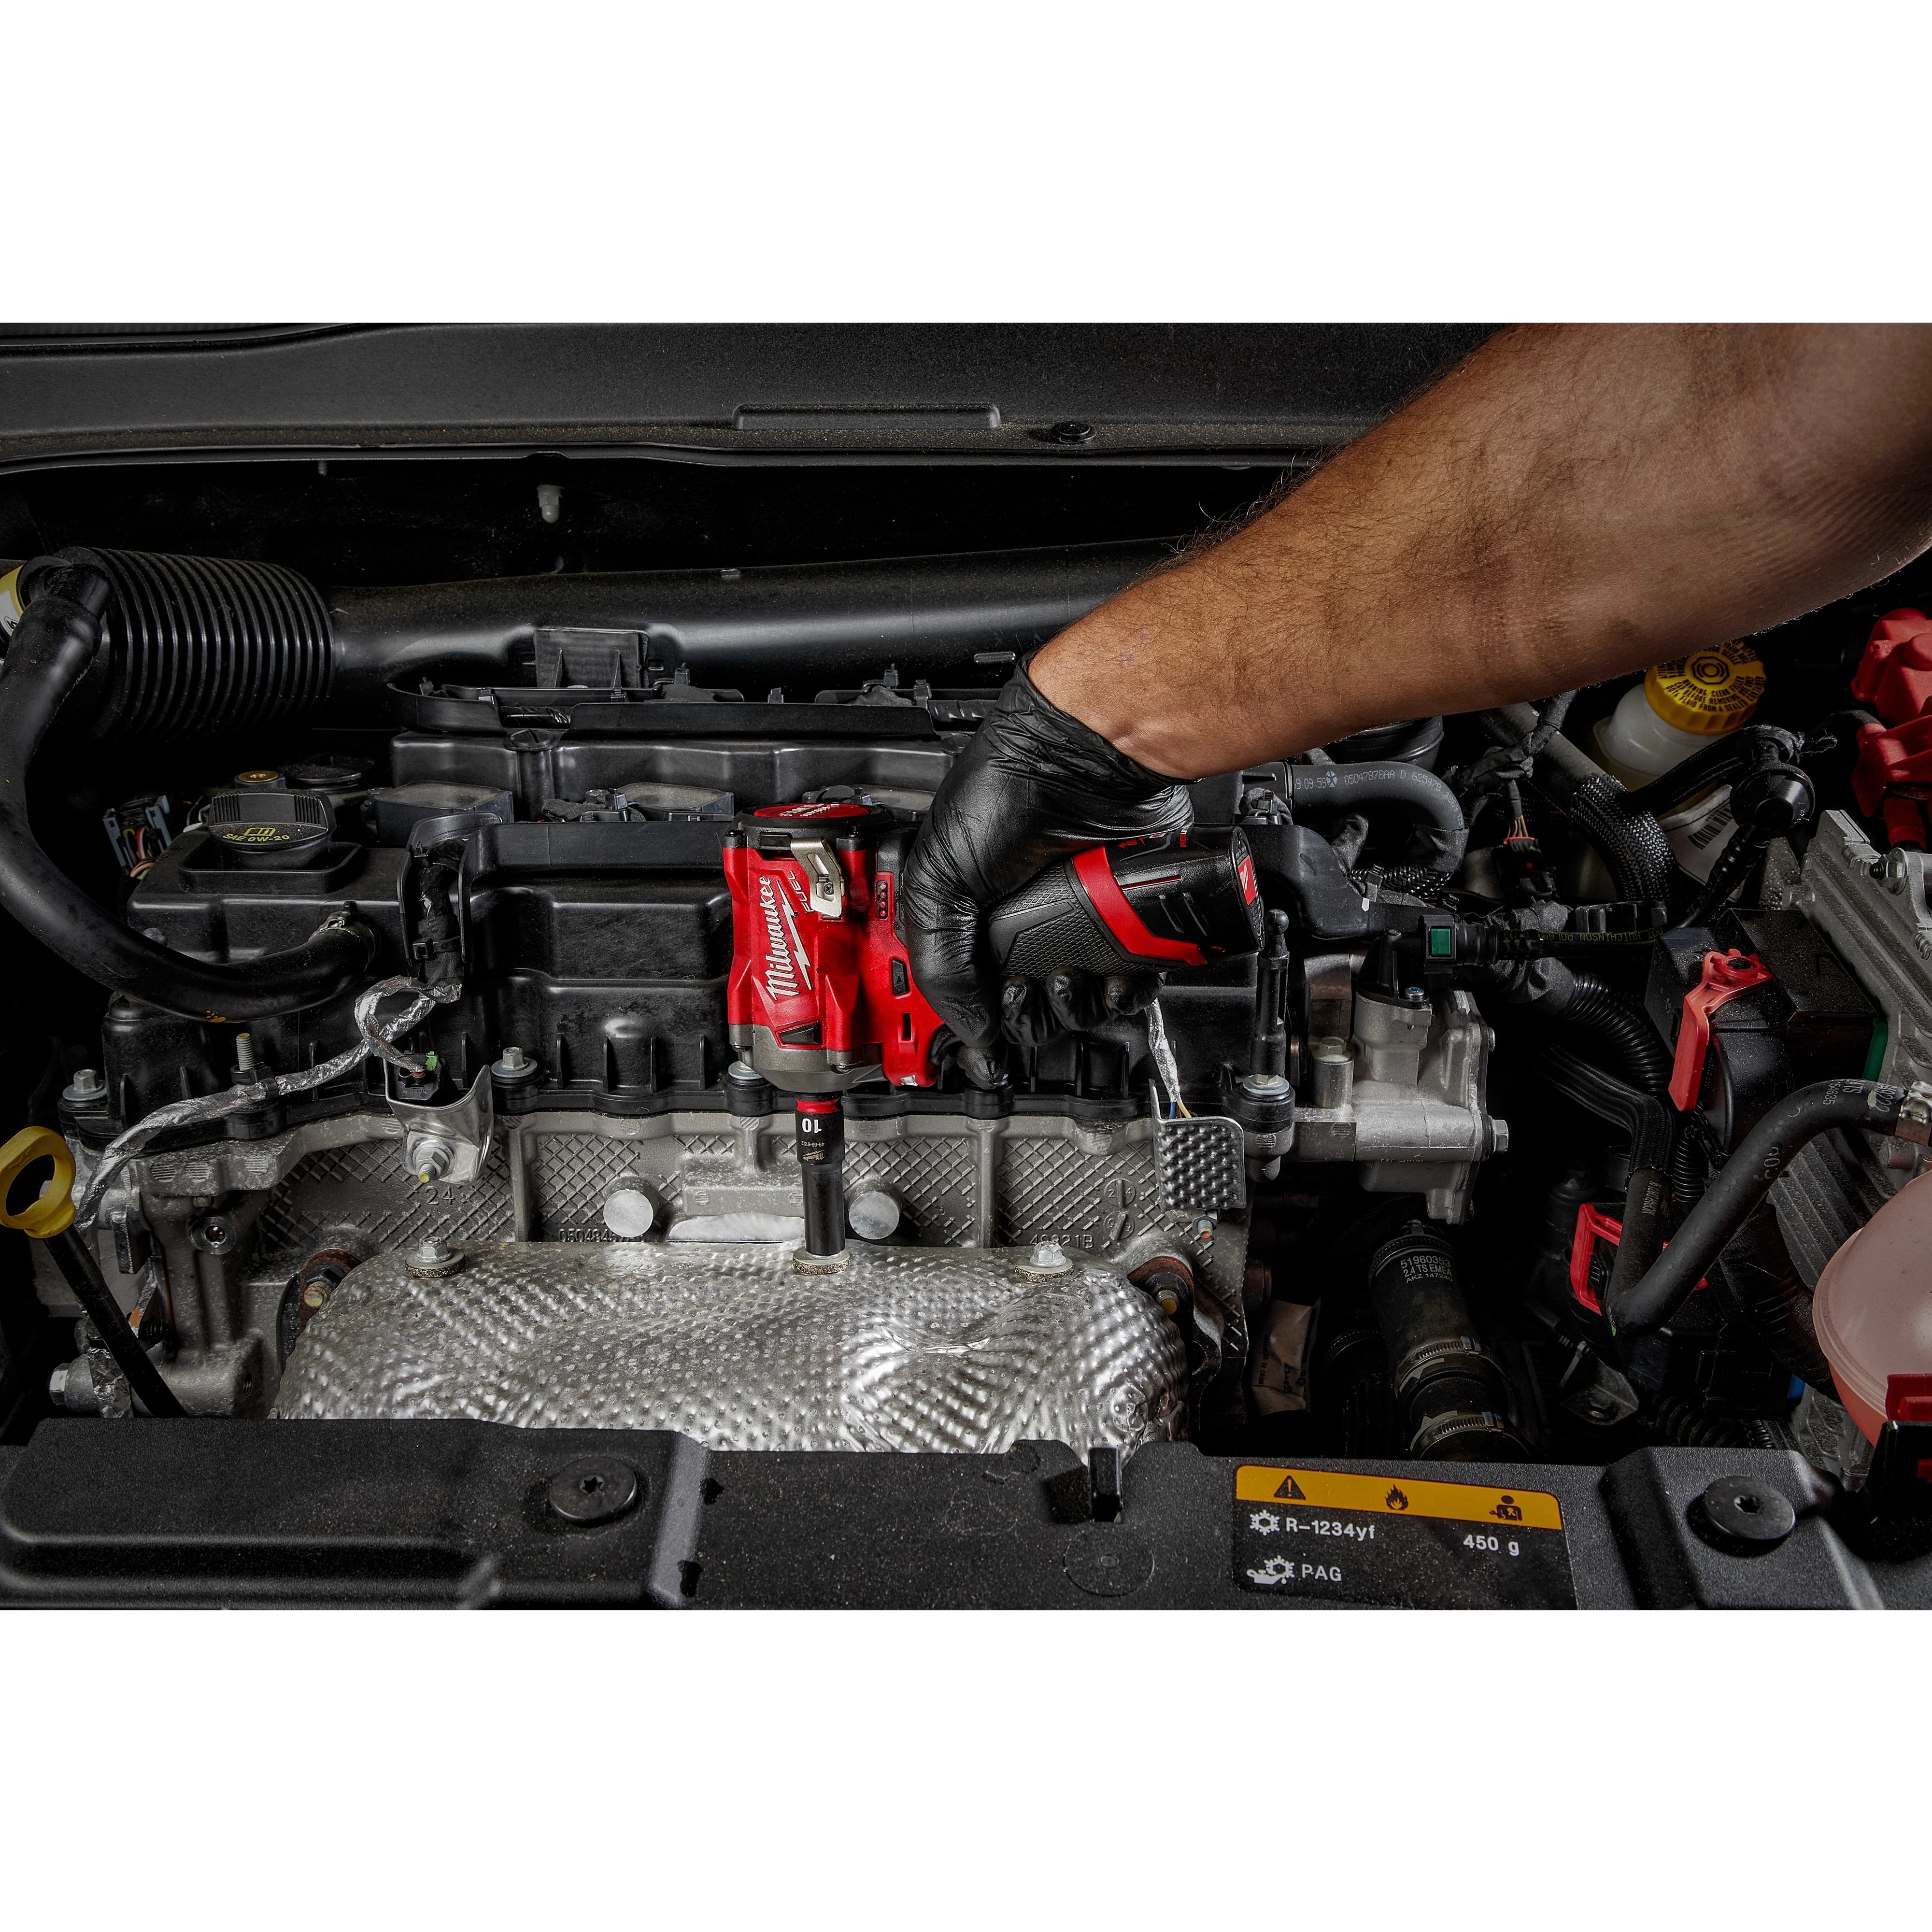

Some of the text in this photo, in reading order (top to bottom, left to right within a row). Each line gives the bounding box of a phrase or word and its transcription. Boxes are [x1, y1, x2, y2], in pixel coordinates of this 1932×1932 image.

[1674, 682, 1686, 690] CAP
[1684, 689, 1706, 703] BEFORE
[1738, 686, 1750, 696] USE
[1744, 676, 1754, 688] ONLY
[1678, 696, 1698, 708] FLUID
[1699, 703, 1717, 711] FROM
[1725, 699, 1748, 711] SEALED
[1746, 676, 1764, 701] CONTAINER
[1712, 688, 1731, 697] CLEAN
[1729, 676, 1745, 692] FILLER
[222, 833, 247, 841] SAE
[787, 870, 814, 913] FUEL
[759, 876, 800, 1001] Milwaukee
[1579, 931, 1641, 942] HUTCHINSON
[802, 1118, 822, 1134] 10
[803, 1152, 825, 1161] Milwaukee
[426, 1185, 455, 1205] 24
[1400, 1255, 1451, 1269] 51960353
[1403, 1264, 1452, 1278] 2.4 TS EMEA
[1406, 1273, 1453, 1284] AKZ 147240
[1286, 1518, 1520, 1556] R-1234yf 450 g
[1302, 1564, 1342, 1582] PAG
